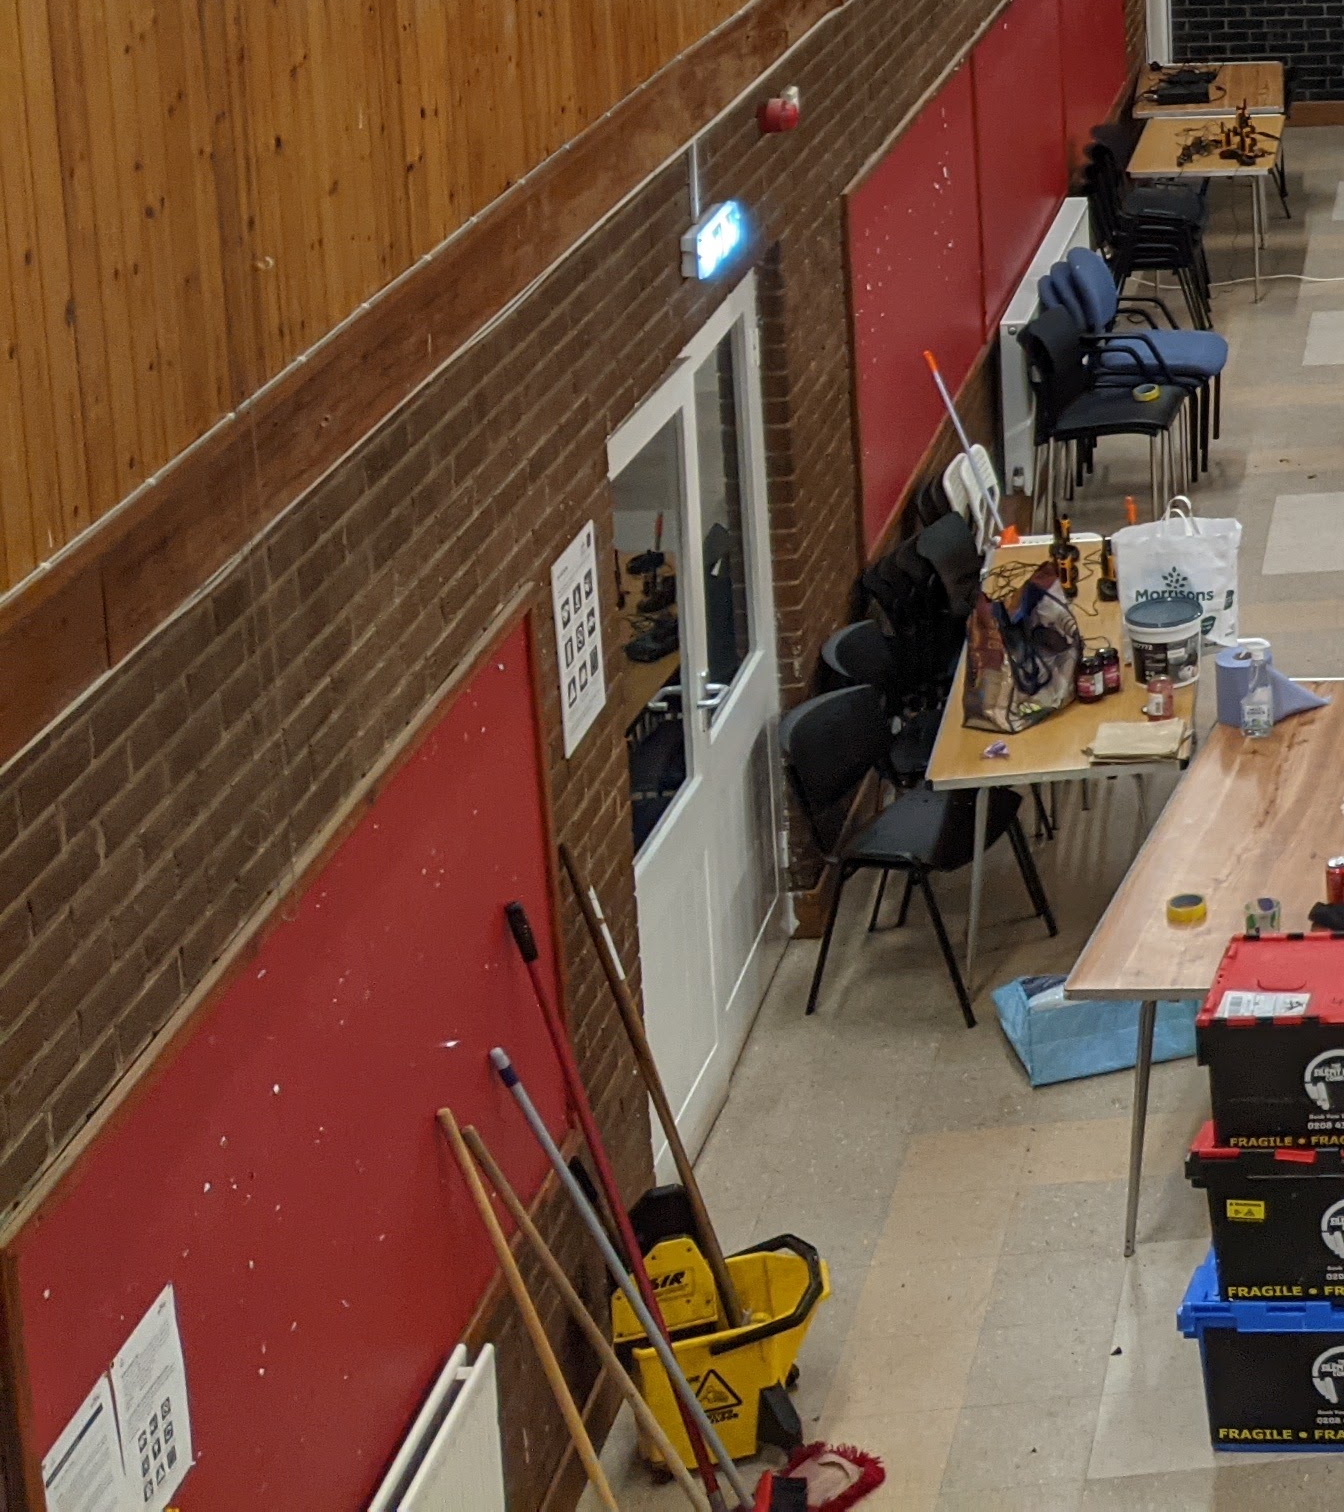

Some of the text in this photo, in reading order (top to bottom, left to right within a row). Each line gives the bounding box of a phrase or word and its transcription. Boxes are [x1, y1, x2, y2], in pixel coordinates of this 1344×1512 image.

[1135, 589, 1214, 602] Morrisons
[1230, 1137, 1293, 1147] FRAGILE
[1228, 1287, 1302, 1297] FRAGILE
[1219, 1429, 1292, 1439] FRAGILE
